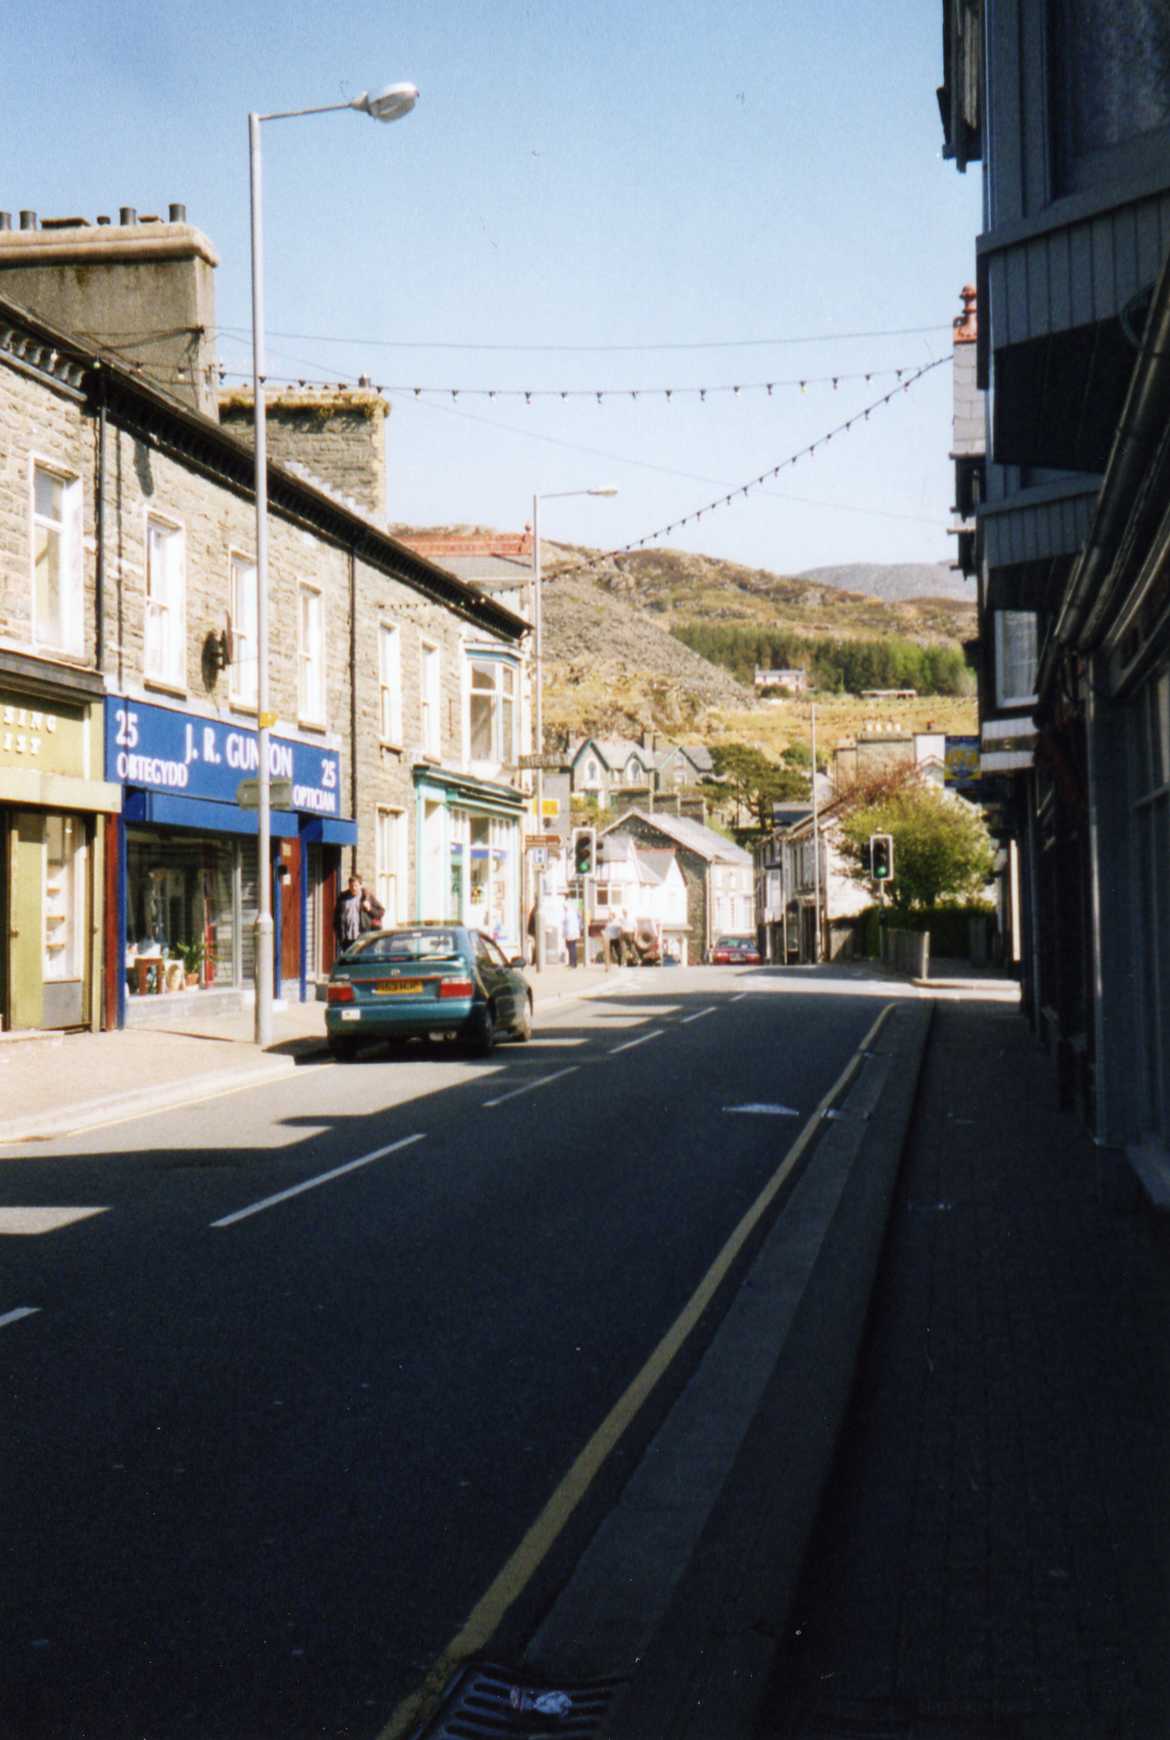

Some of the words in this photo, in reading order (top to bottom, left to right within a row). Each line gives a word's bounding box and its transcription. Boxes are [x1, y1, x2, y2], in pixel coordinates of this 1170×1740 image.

[115, 709, 138, 748] 25
[184, 723, 198, 764] J.
[203, 727, 221, 764] R.
[226, 733, 292, 778] GUNON
[321, 758, 336, 788] 25
[293, 785, 336, 812] OPTICIAN
